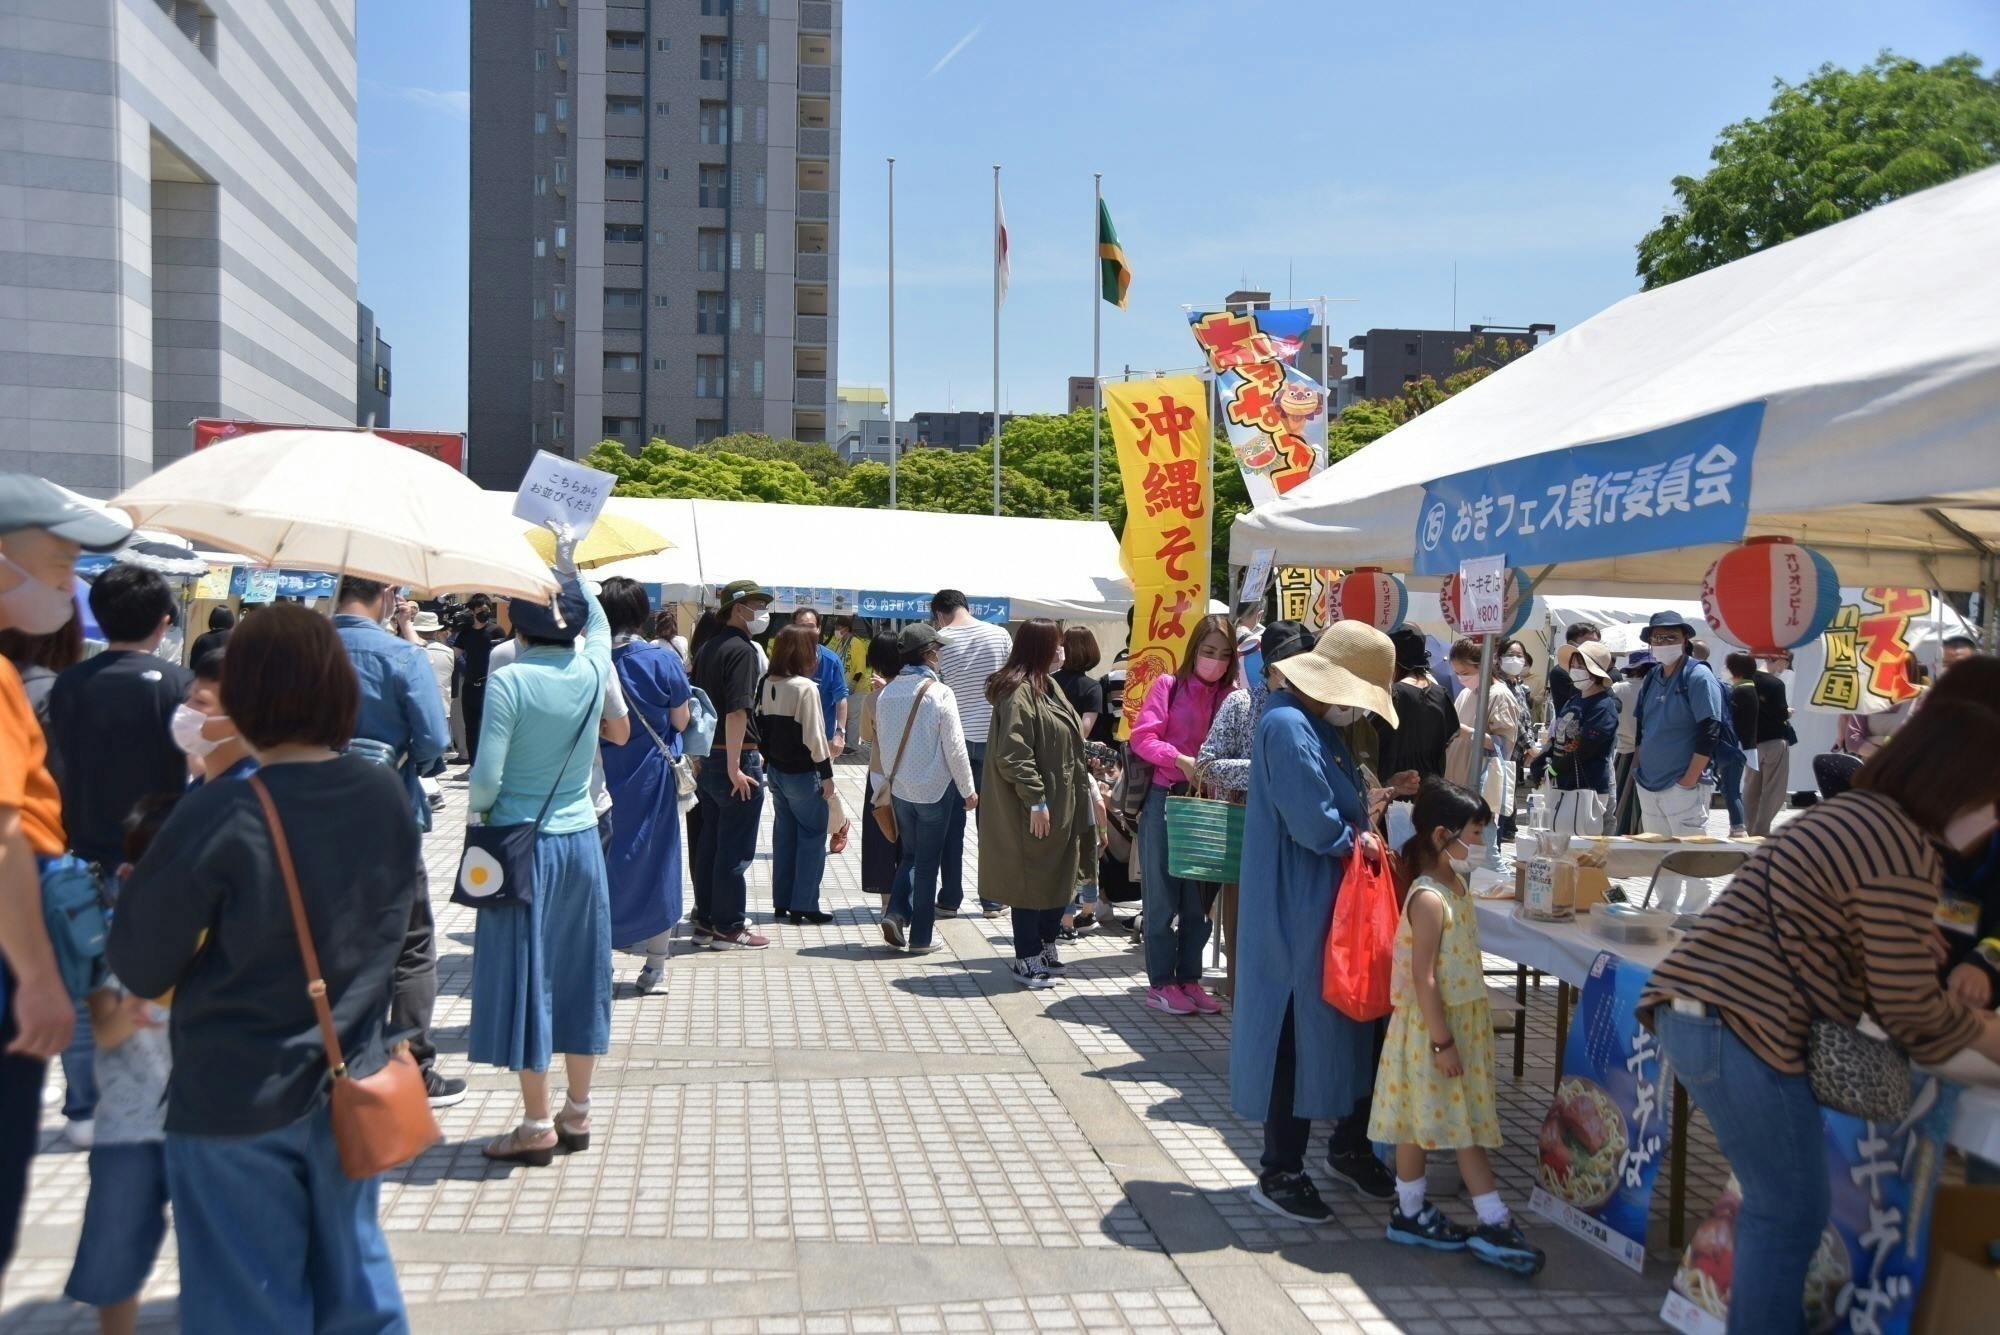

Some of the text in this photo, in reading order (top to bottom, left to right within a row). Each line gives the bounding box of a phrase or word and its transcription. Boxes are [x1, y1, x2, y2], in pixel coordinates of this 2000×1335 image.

[549, 473, 598, 498] こちらから
[1130, 396, 1205, 642] 沖縄そば
[1451, 444, 1737, 542] おきフェス実行委員会
[880, 600, 905, 612] 内子町
[1784, 553, 1801, 626] オリオンビール
